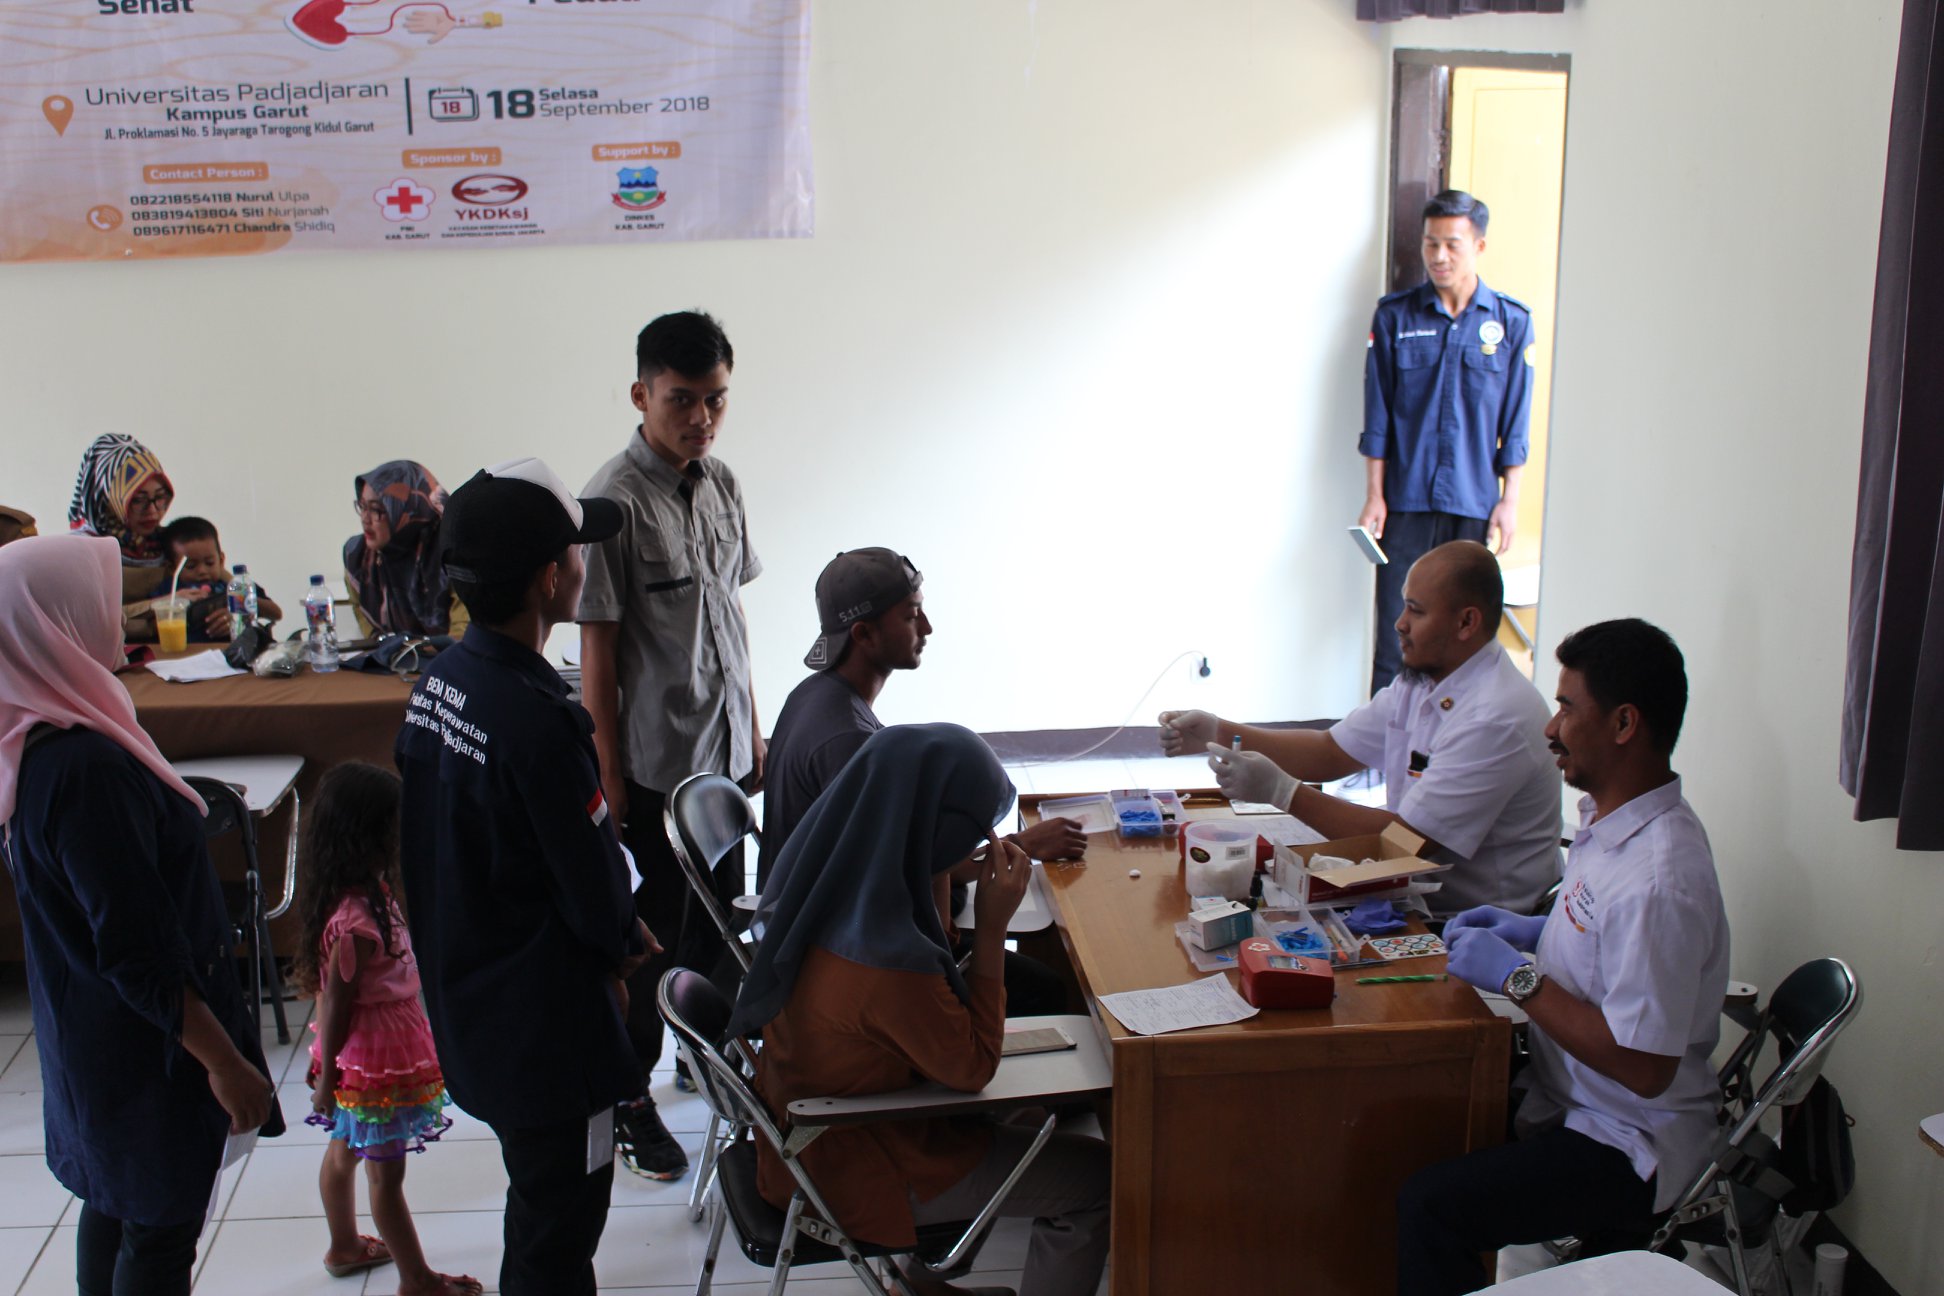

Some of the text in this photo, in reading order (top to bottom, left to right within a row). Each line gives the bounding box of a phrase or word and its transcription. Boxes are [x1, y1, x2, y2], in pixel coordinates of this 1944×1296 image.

[85, 80, 388, 106] Universitas Padjadjaran
[539, 87, 598, 100] Selasa
[441, 101, 461, 113] 18
[487, 89, 535, 120] 18
[540, 97, 710, 120] September 2018
[166, 104, 309, 124] Kampus Garut
[118, 127, 179, 140] Proklamasi
[181, 126, 199, 137] No.
[202, 126, 209, 137] 5
[211, 125, 258, 139] Jayaraga
[260, 123, 312, 138] Tarogong
[314, 122, 342, 133] Kidul
[344, 121, 375, 133] Garut
[409, 153, 467, 166] Sponsor
[471, 151, 488, 164] by
[598, 144, 650, 159] Support
[652, 144, 669, 157] by
[150, 168, 203, 180] Contact
[207, 167, 255, 178] Person
[236, 192, 274, 203] Nurul
[278, 191, 310, 204] Ulpa
[242, 207, 264, 218] Siti
[267, 205, 330, 219] Nurjanah
[456, 207, 529, 221] YKDKsj
[234, 221, 291, 233] Chandra
[294, 220, 336, 234] Shidiq
[426, 676, 467, 711] BEM KEMA
